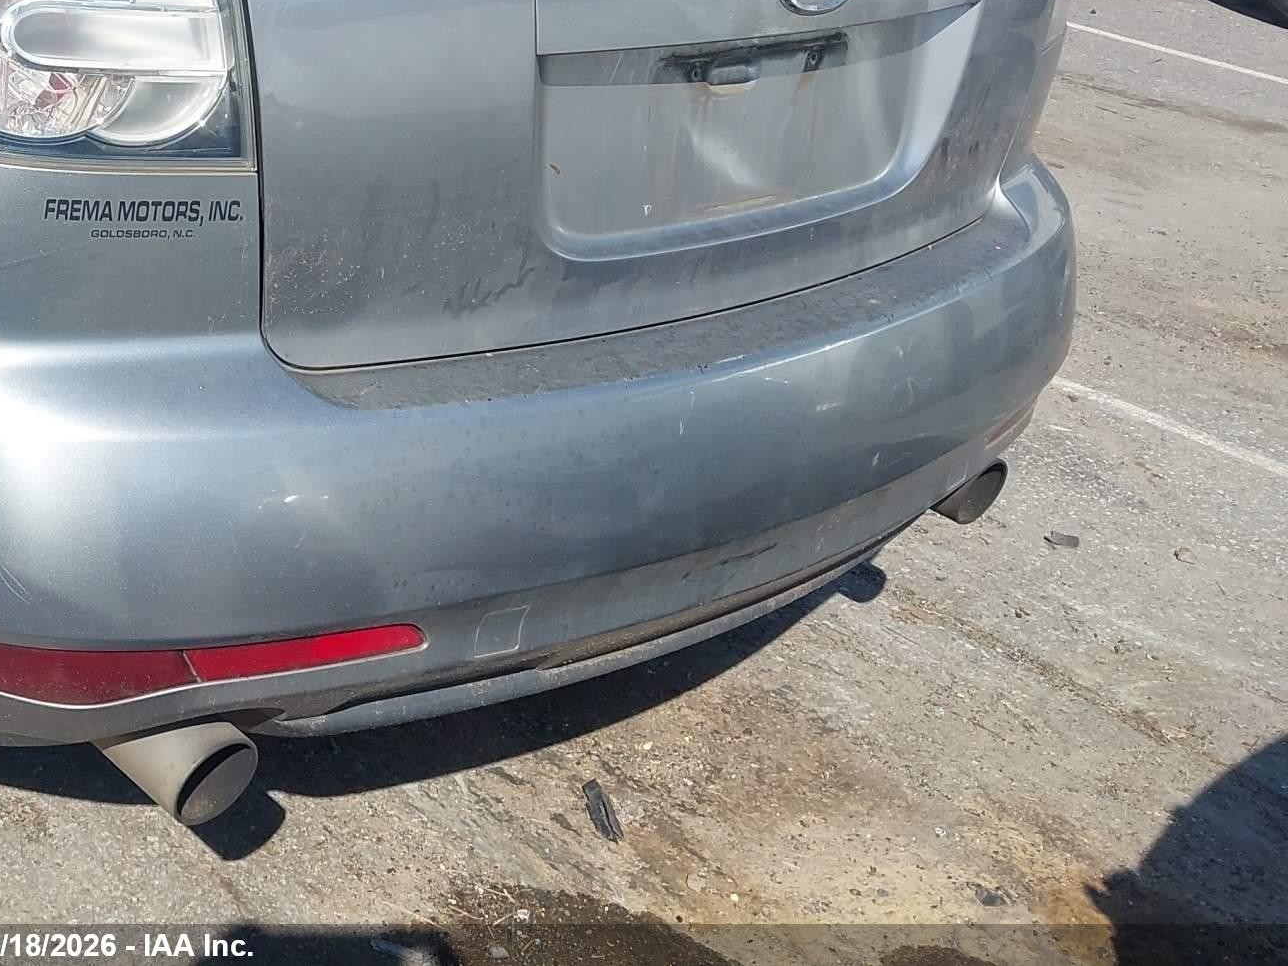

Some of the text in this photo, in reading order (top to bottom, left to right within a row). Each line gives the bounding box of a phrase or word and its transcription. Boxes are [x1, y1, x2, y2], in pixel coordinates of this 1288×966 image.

[44, 199, 244, 227] FREMA MOTORS, INC.
[90, 229, 196, 240] GOLDSBORO, N.C.
